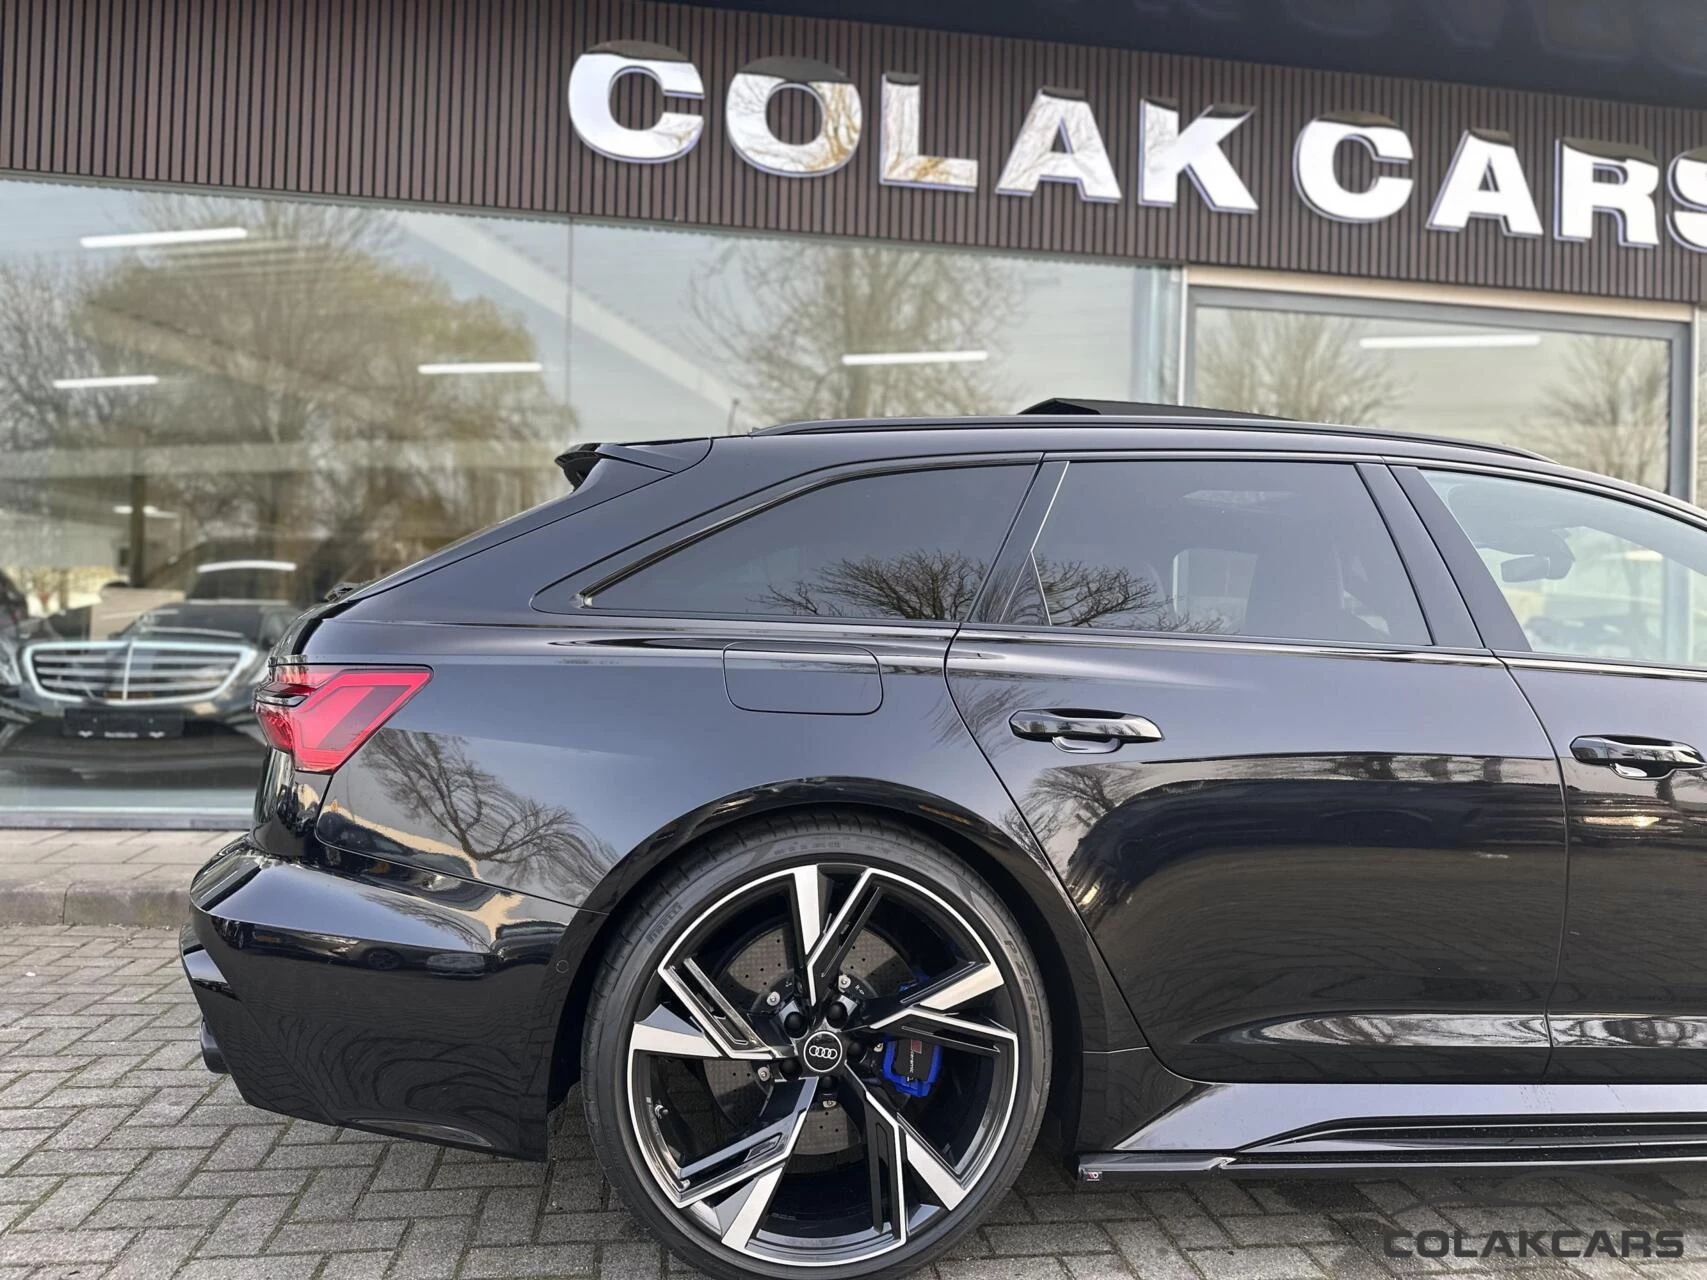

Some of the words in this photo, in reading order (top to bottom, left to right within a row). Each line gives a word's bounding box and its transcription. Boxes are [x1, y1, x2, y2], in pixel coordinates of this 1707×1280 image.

[568, 40, 1259, 214] COLAK
[1004, 941, 1018, 954] P
[1015, 960, 1041, 1033] ZERO
